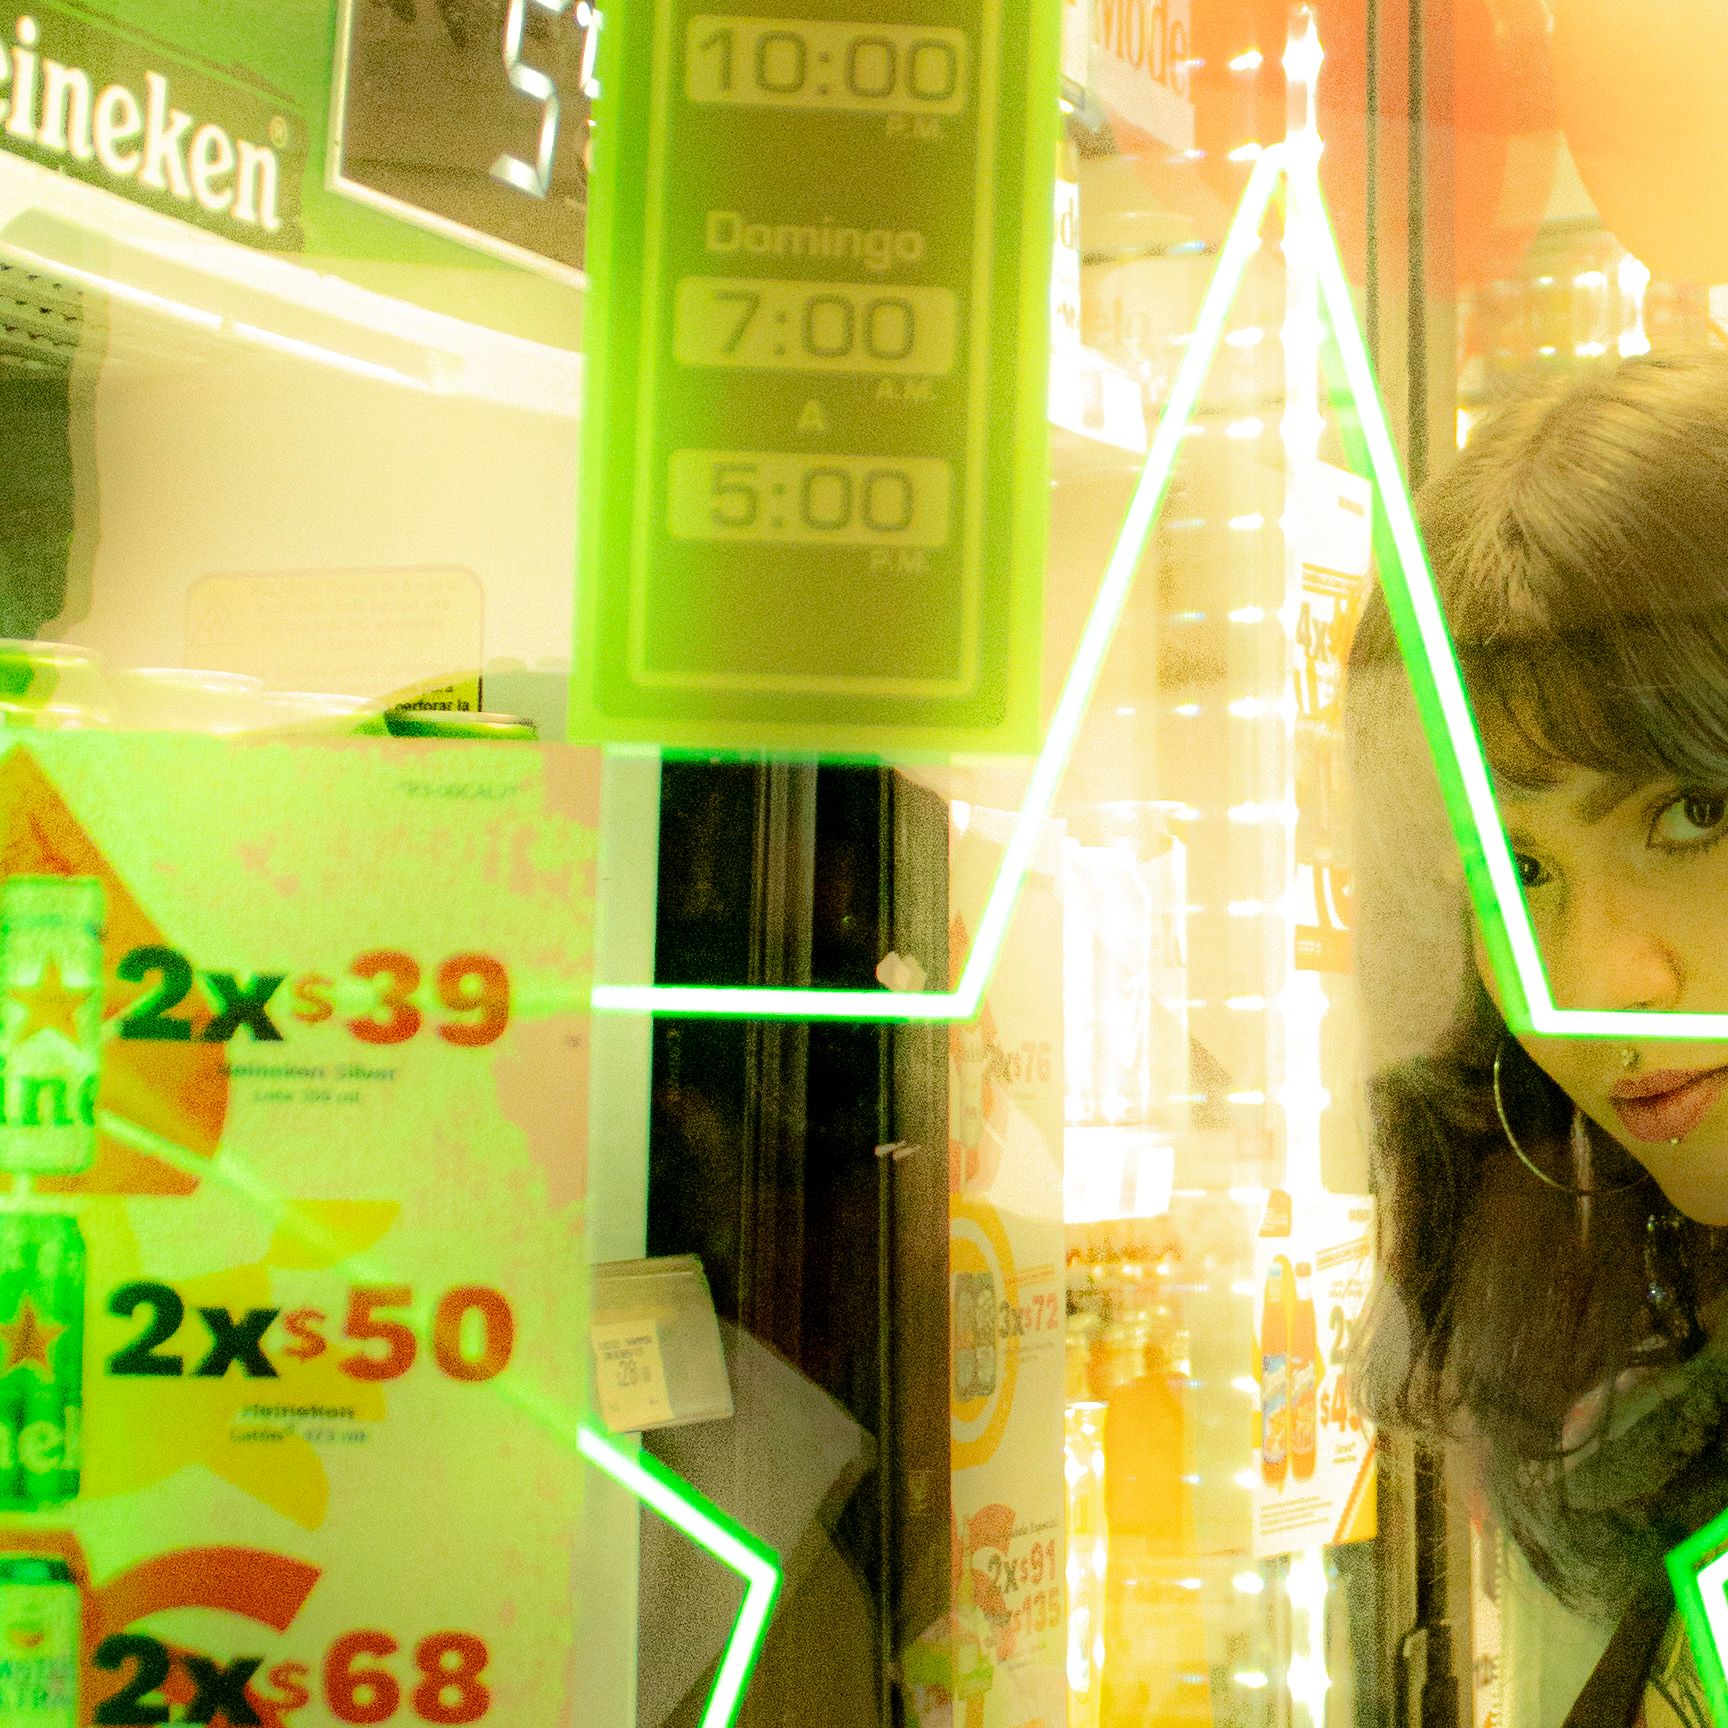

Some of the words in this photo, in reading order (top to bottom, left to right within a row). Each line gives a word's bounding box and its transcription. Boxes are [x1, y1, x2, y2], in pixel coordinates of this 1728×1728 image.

[699, 28, 957, 103] 10:00
[0, 15, 284, 234] ineken
[705, 210, 926, 272] Domingo
[711, 290, 917, 361] 7:00
[798, 400, 827, 434] A
[708, 463, 917, 534] 5:00
[115, 944, 511, 1048] 2x$39
[107, 1280, 515, 1383] 2x$50
[92, 1628, 492, 1728] 2x$68
